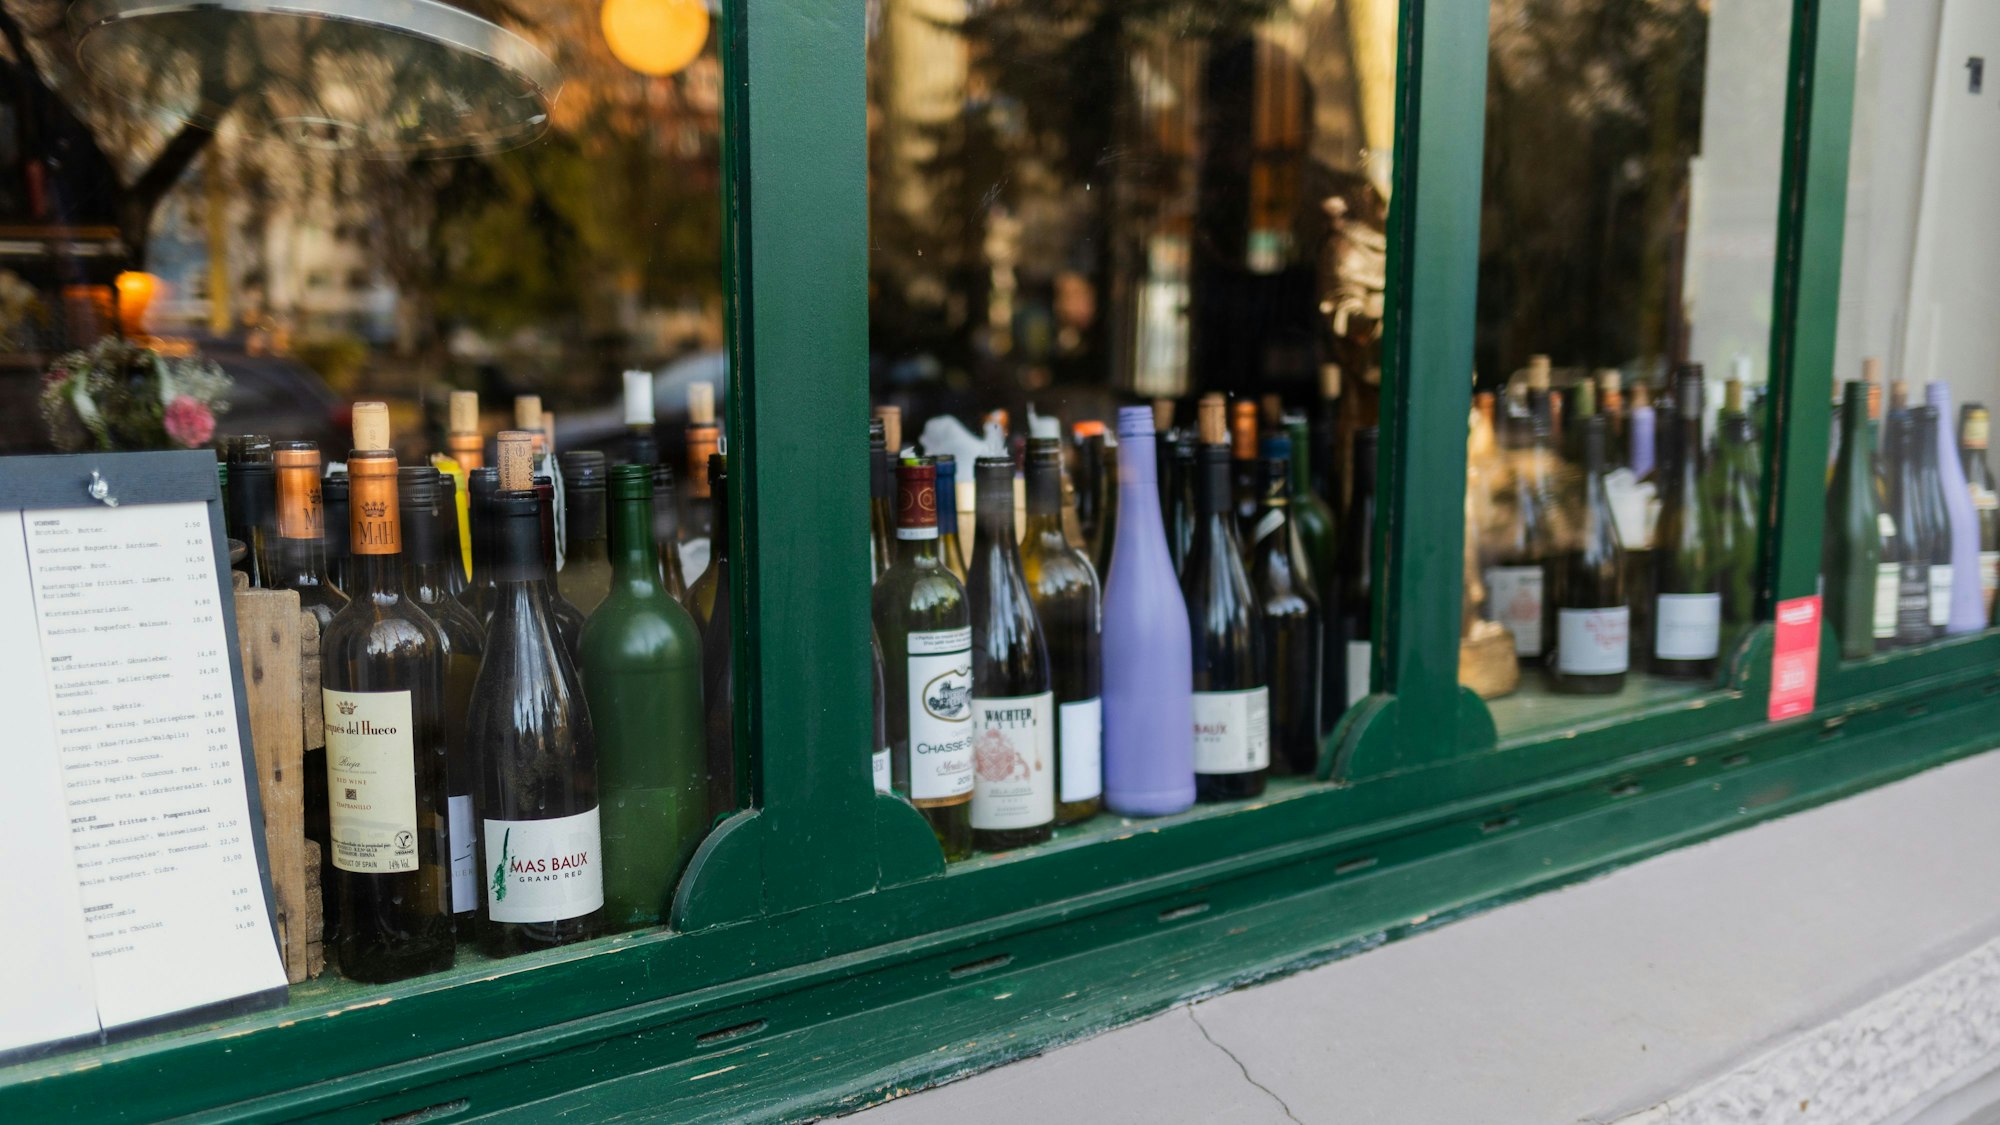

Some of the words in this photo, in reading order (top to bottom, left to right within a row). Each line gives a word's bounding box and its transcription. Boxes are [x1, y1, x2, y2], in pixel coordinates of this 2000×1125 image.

[985, 707, 1033, 722] WACHTER
[346, 720, 359, 735] del
[361, 720, 397, 736] Hueco
[362, 860, 378, 869] SPAIN
[552, 851, 588, 871] BAUX
[519, 874, 559, 883] GRAND
[564, 869, 583, 879] RED
